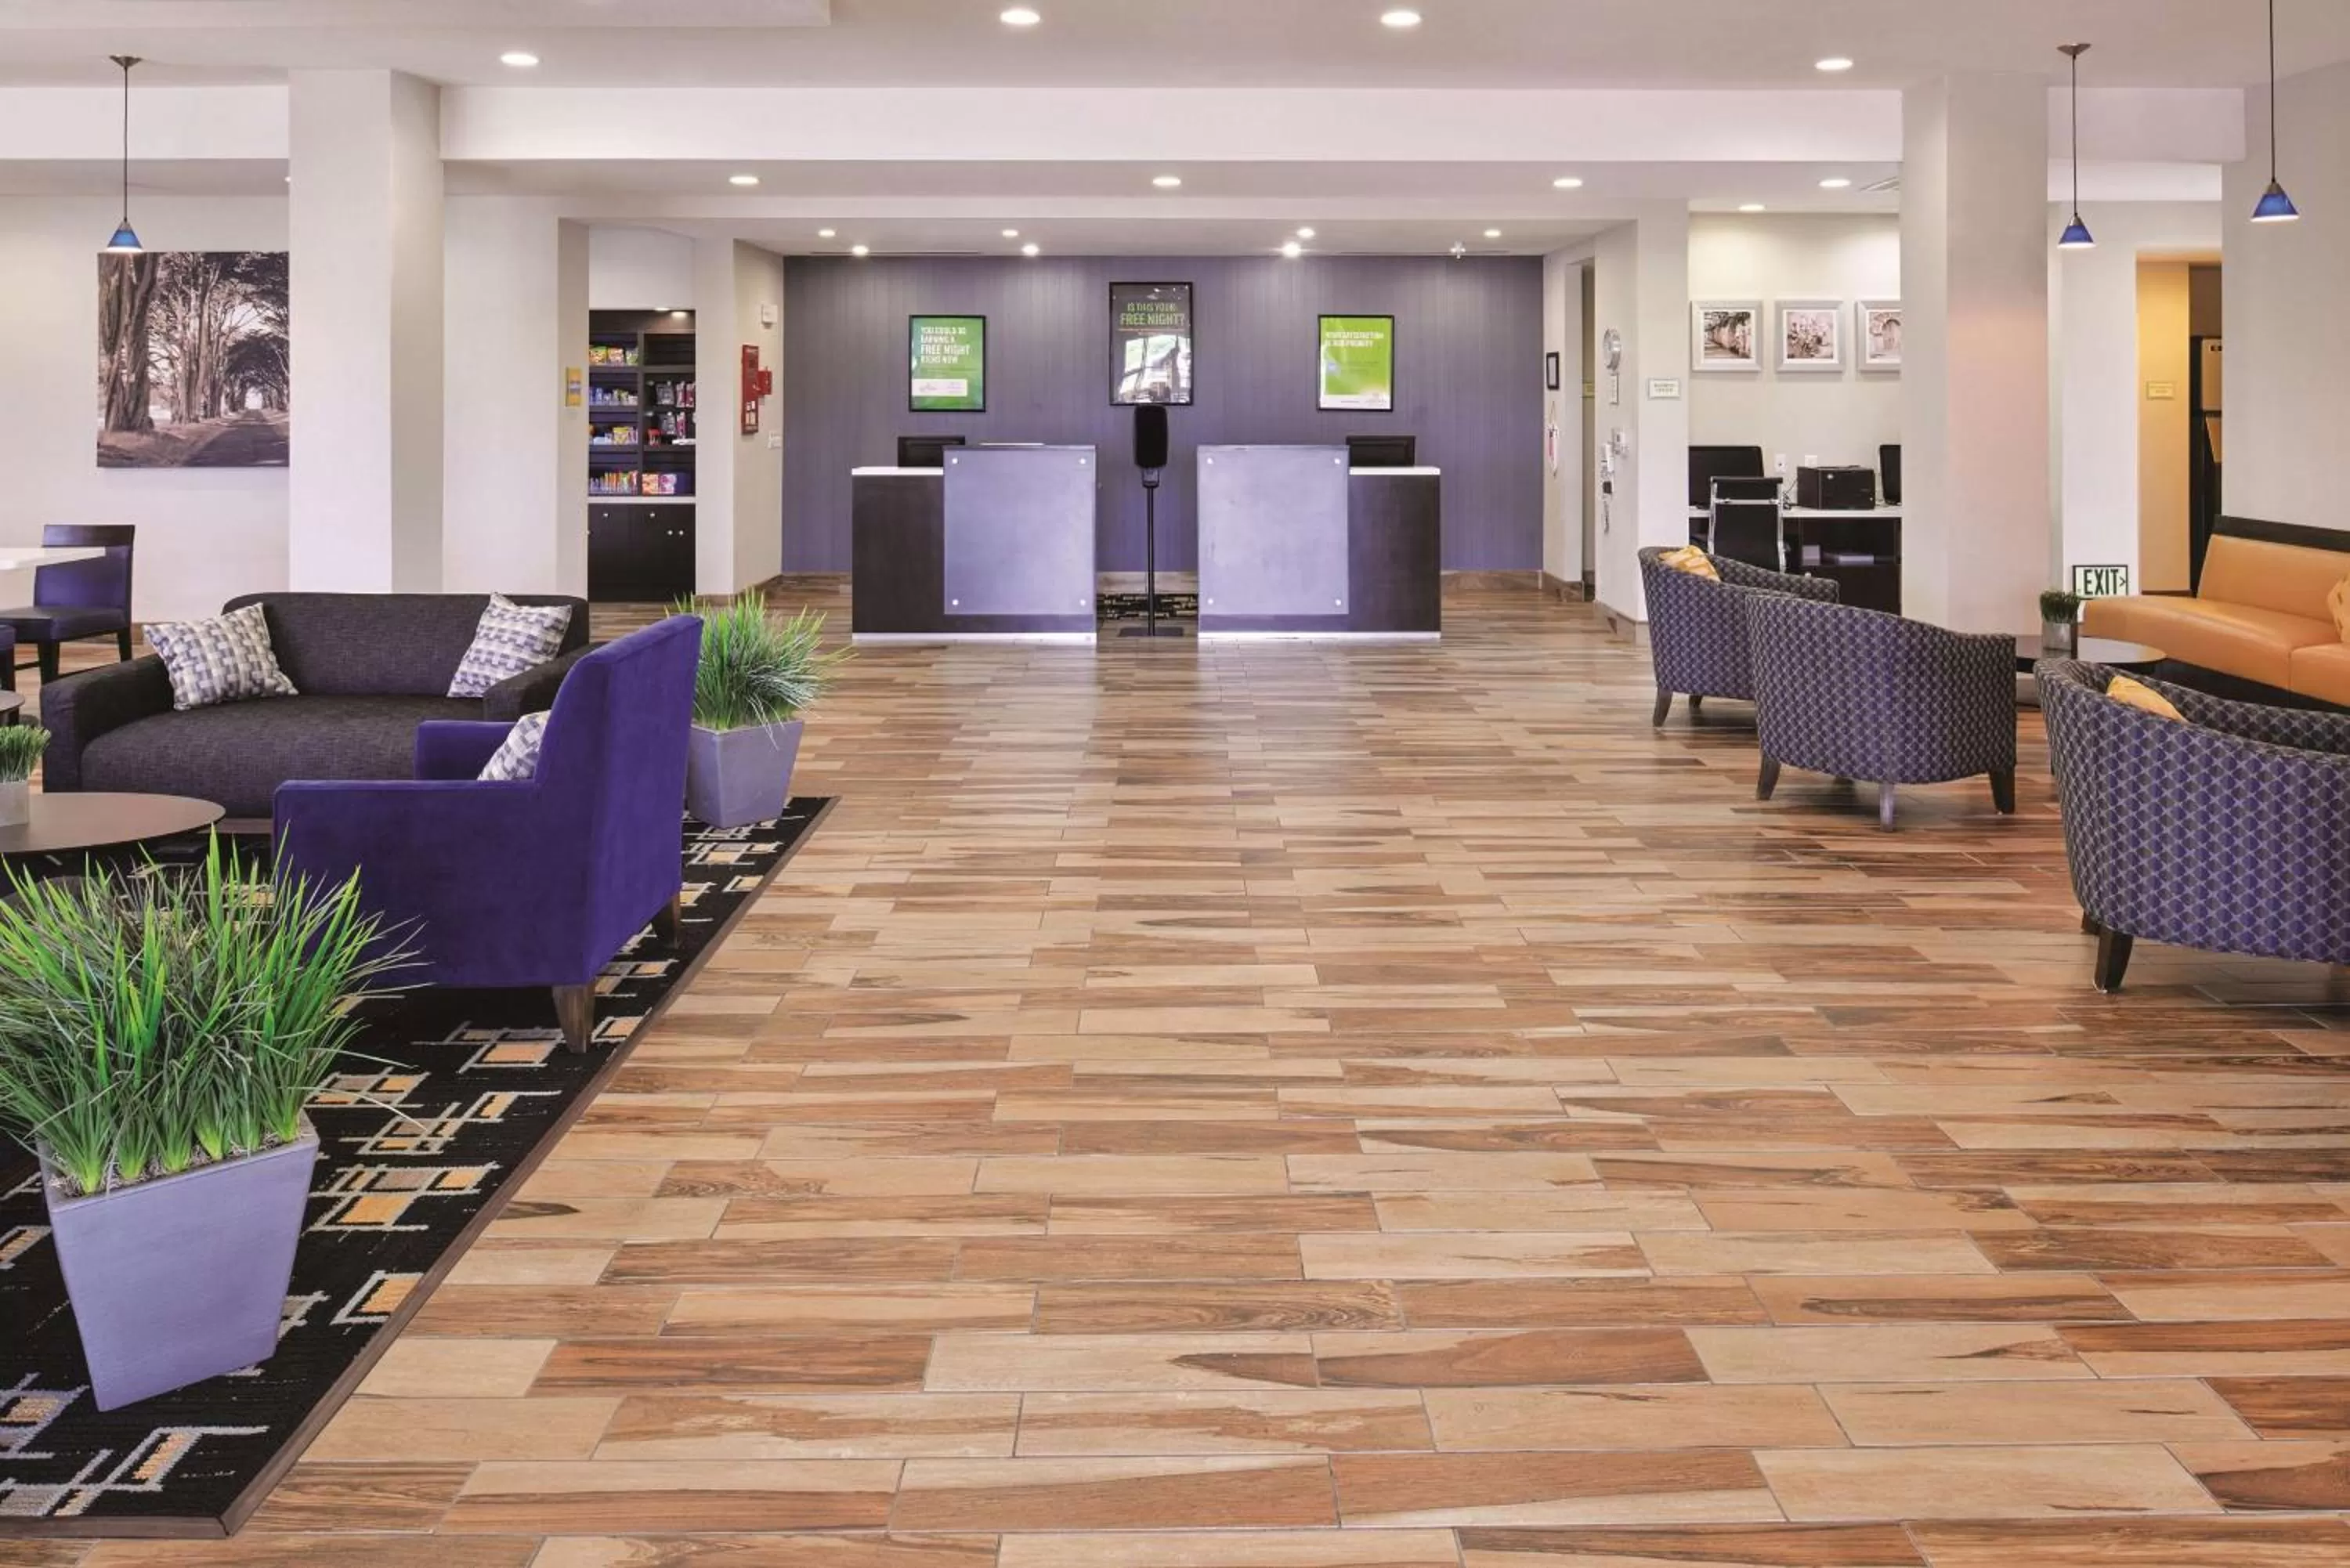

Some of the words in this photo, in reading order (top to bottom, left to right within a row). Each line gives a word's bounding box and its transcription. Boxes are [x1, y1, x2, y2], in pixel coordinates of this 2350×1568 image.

[1127, 303, 1135, 312] IS
[1120, 313, 1147, 325] FREE
[1148, 313, 1185, 326] NIGHT?
[920, 344, 941, 355] FREE
[2084, 569, 2119, 595] EXIT
